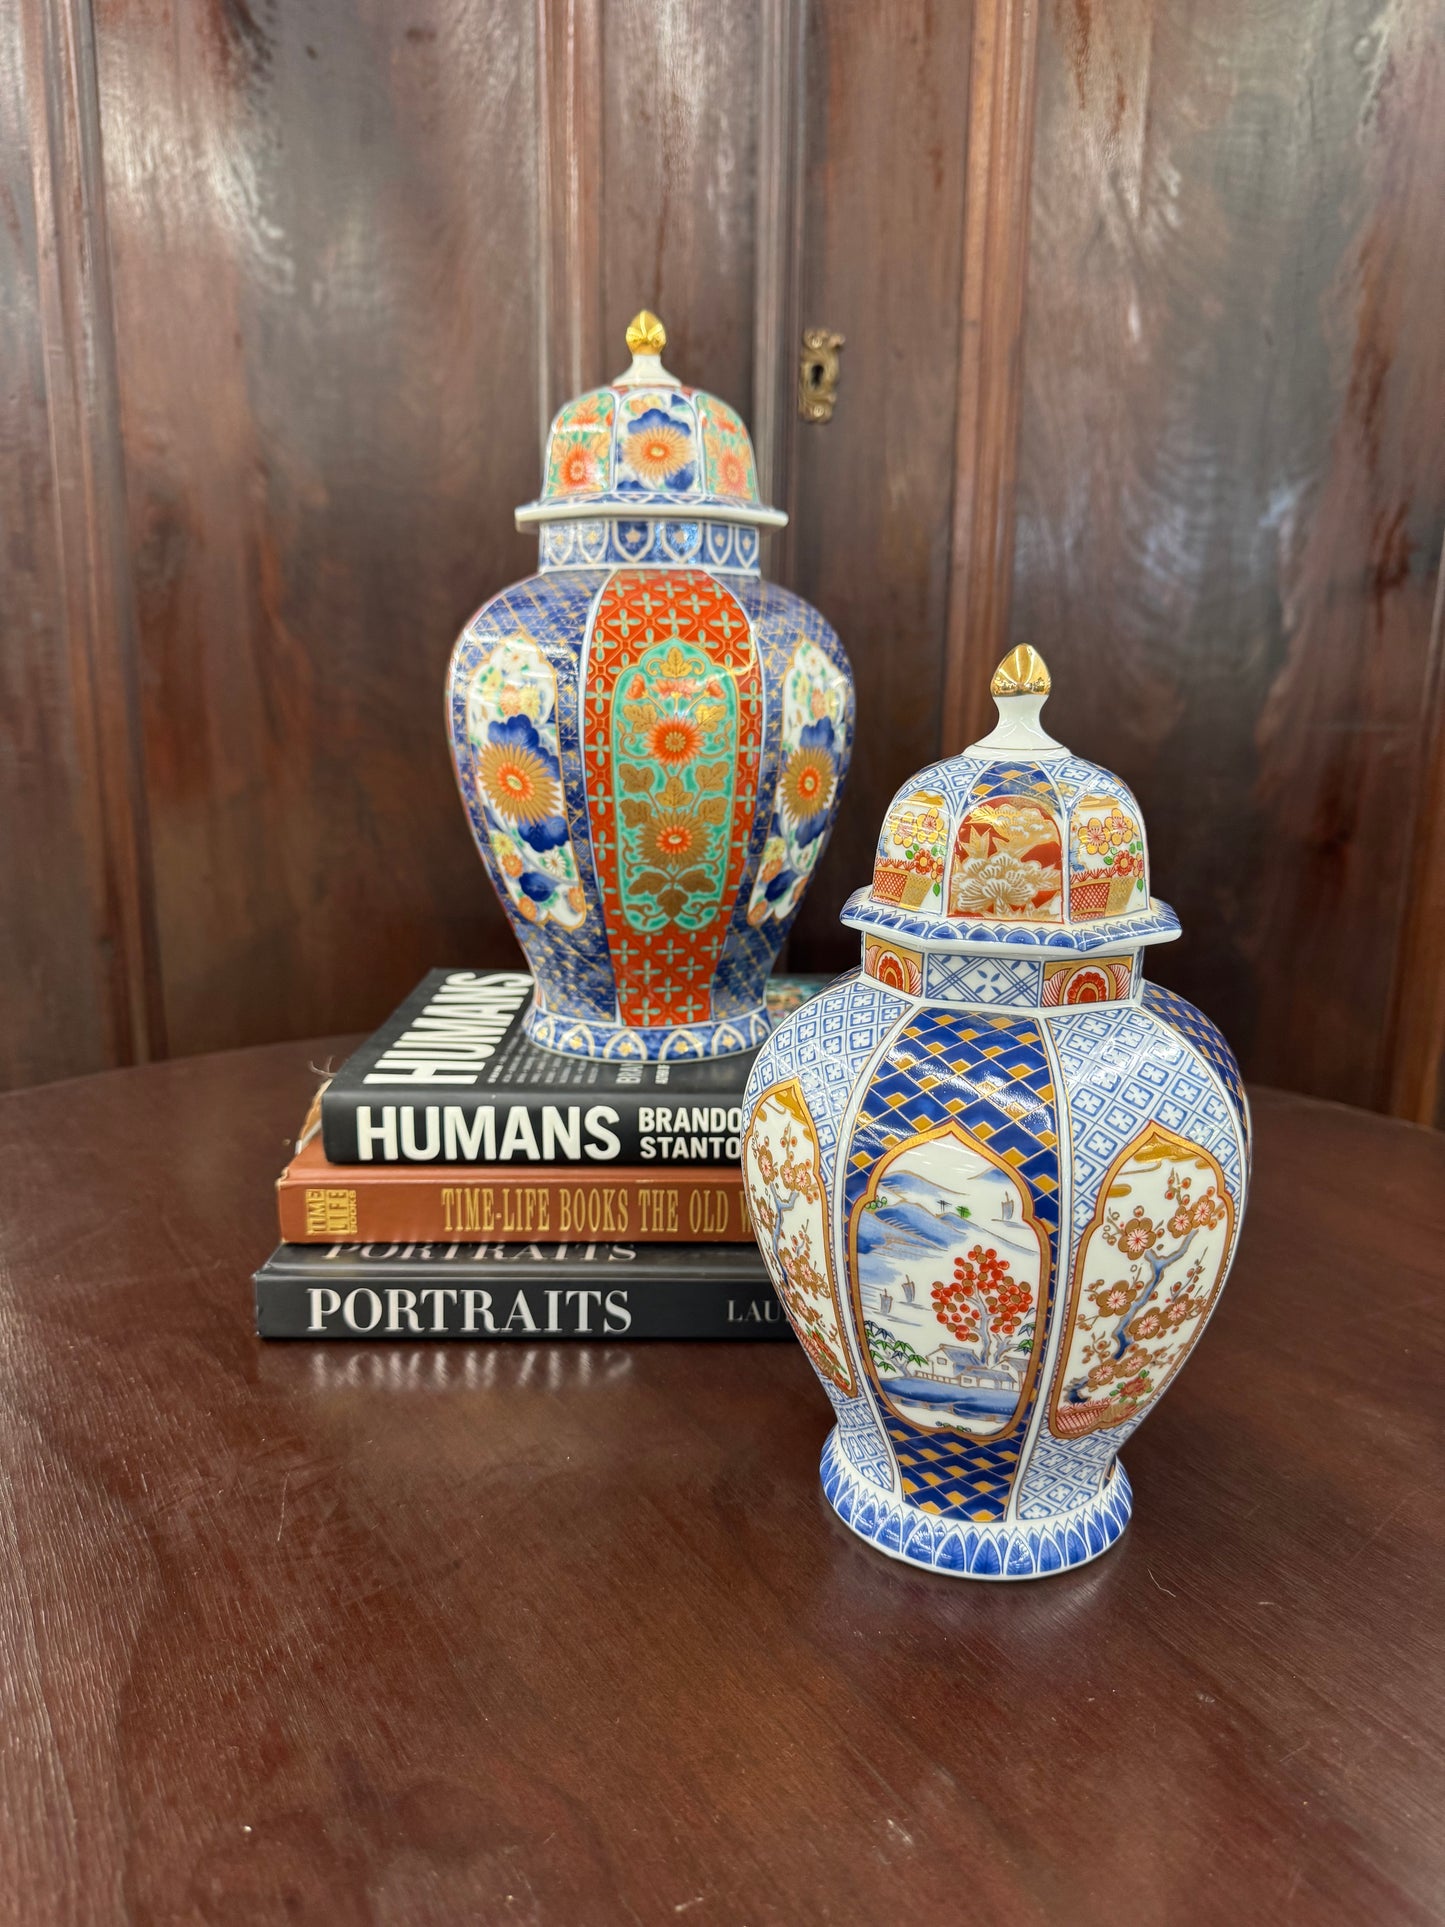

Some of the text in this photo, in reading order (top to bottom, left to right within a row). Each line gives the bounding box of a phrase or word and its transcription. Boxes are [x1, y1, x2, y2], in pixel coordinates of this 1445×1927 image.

[363, 972, 535, 1084] HUMANS
[356, 1106, 621, 1160] HUMANS
[638, 1107, 742, 1133] BRANDO
[640, 1137, 741, 1159] STANTO
[305, 1189, 326, 1236] TIME
[328, 1190, 348, 1233] LIFE
[349, 1190, 358, 1233] BOOKS
[559, 1188, 629, 1232] BOOKS
[638, 1189, 679, 1233] THE
[689, 1189, 729, 1233] OLD
[305, 1287, 633, 1334] PORTRAITS
[727, 1299, 789, 1323] LAU
